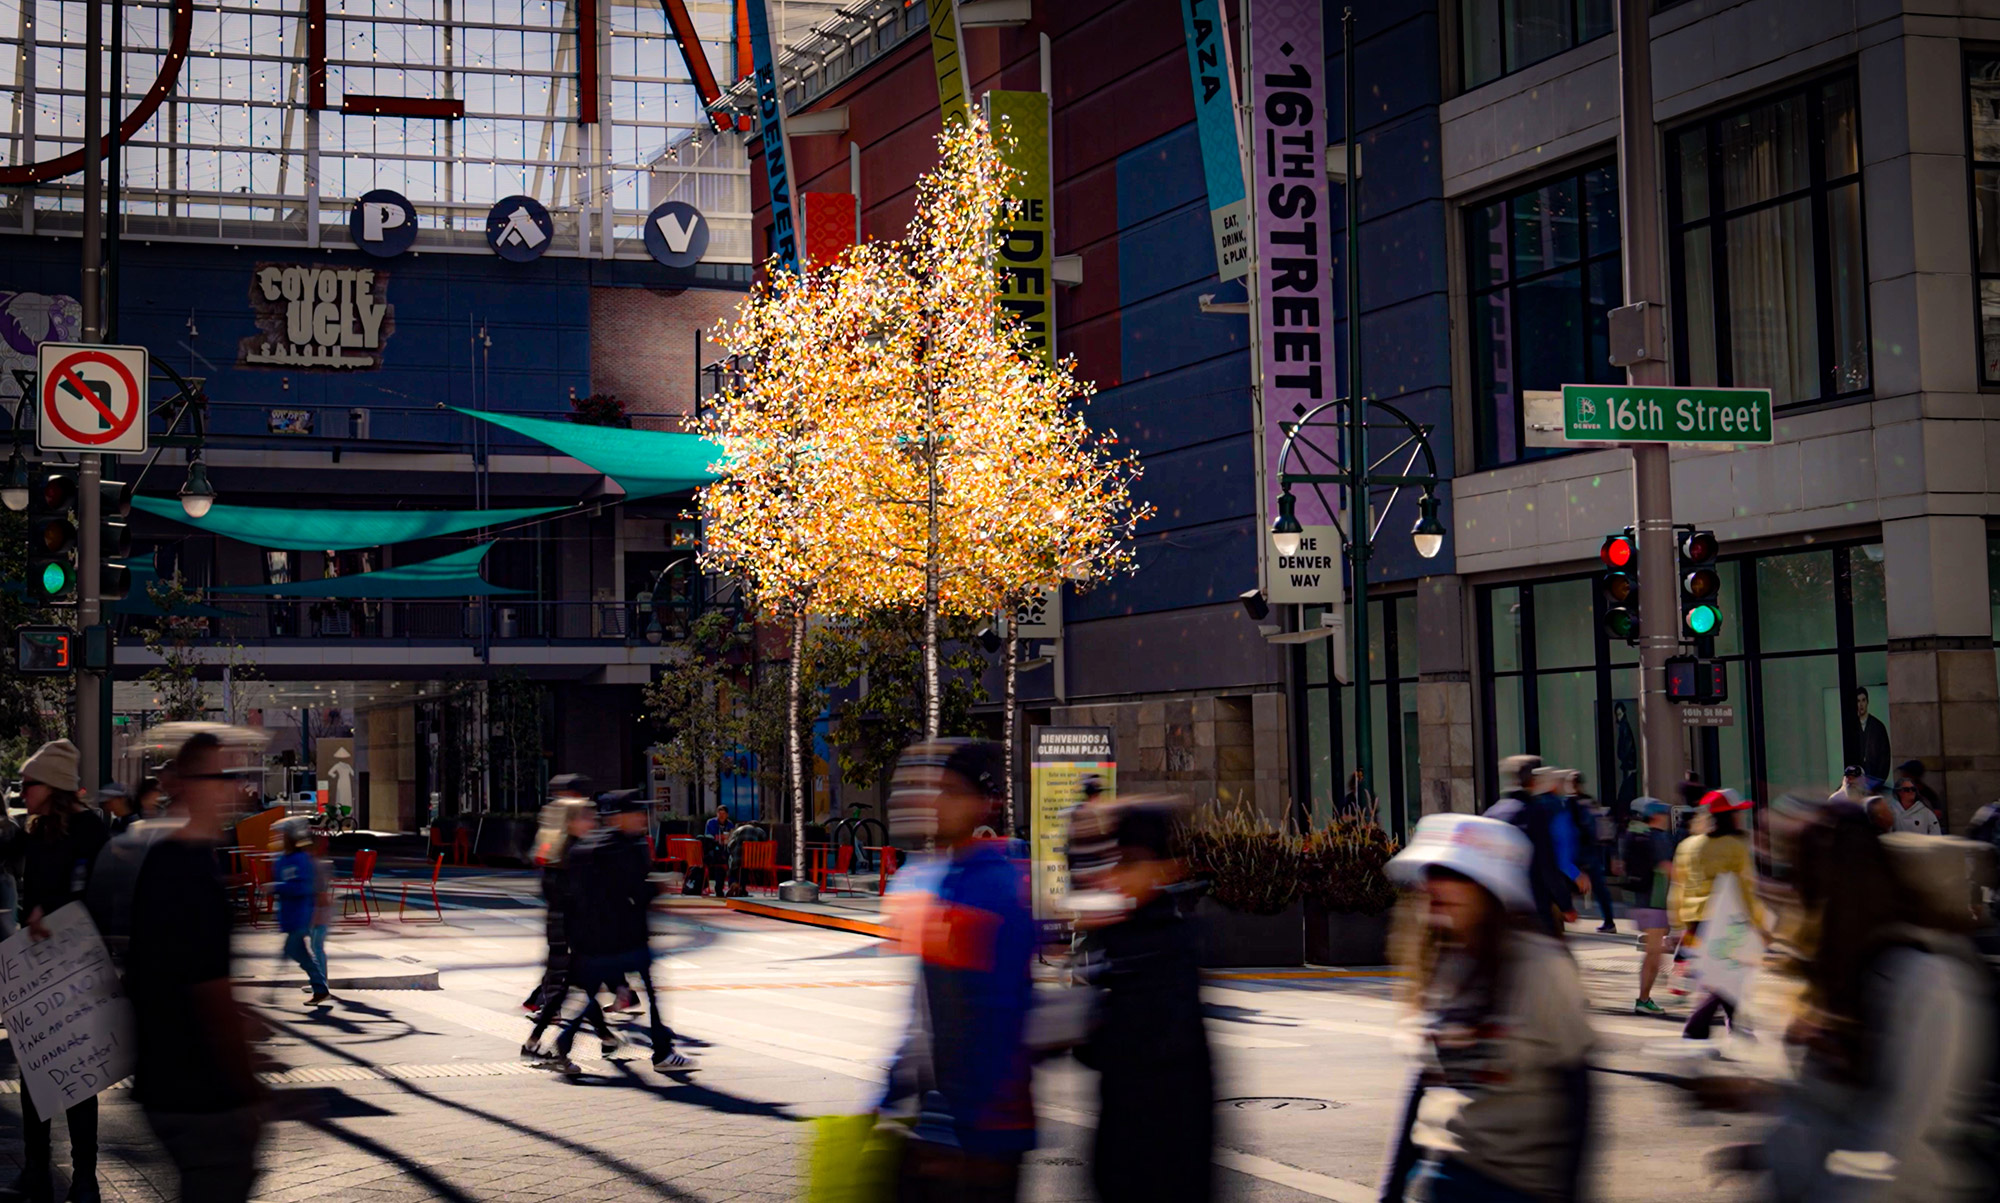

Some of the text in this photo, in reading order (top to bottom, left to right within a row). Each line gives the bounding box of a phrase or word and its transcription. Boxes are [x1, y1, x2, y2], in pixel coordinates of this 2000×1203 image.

[761, 88, 796, 264] DENVER
[363, 202, 406, 242] P
[656, 212, 699, 253] V
[1224, 214, 1239, 229] EAT,
[1222, 230, 1246, 248] DRINK,
[1265, 64, 1323, 399] 16TH STREET
[1223, 246, 1247, 265] & PLAY
[257, 265, 375, 304] COYOTE
[286, 301, 387, 348] UGLY
[261, 342, 341, 358] SALOON
[1606, 397, 1762, 432] 16th Street
[1573, 422, 1601, 430] DENVER
[1279, 556, 1331, 568] DENVER
[1291, 574, 1320, 586] WAY
[56, 635, 69, 667] 3
[1682, 708, 1733, 717] 16th St Mall
[1041, 734, 1109, 744] BIENVENIDOS A
[1038, 745, 1111, 755] GLENARM PLAZA
[2, 966, 55, 1008] AGAINST
[7, 1010, 34, 1035] We
[34, 992, 66, 1017] DID
